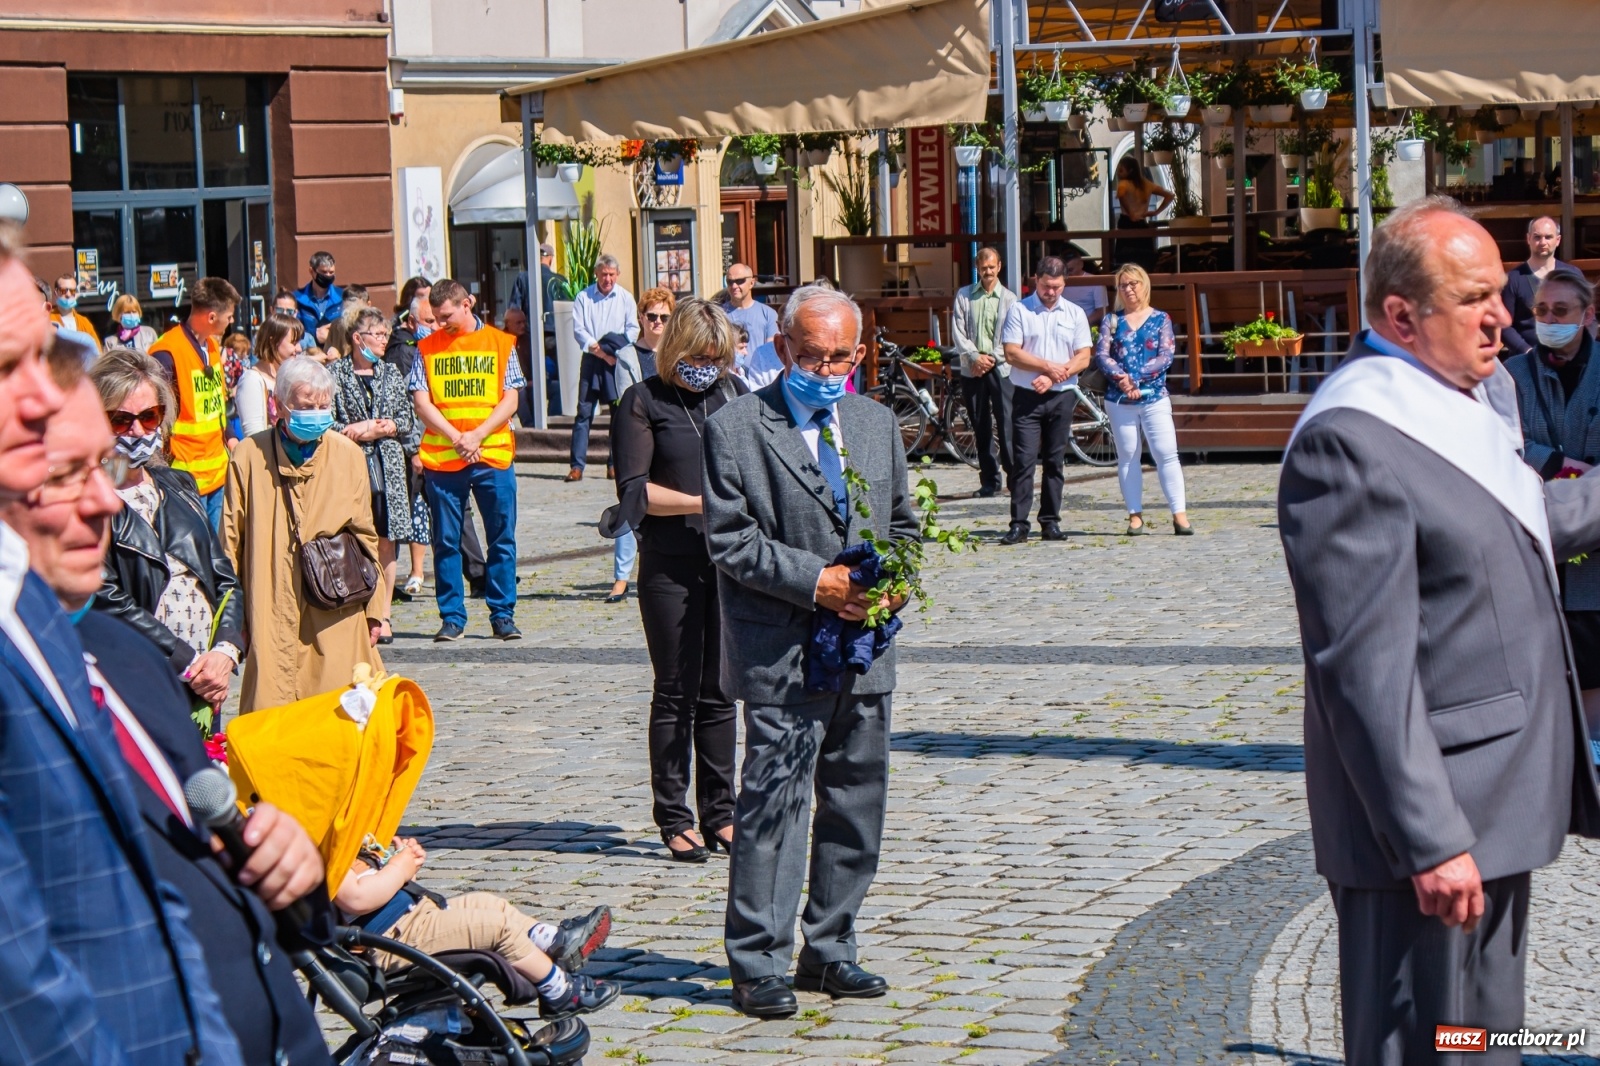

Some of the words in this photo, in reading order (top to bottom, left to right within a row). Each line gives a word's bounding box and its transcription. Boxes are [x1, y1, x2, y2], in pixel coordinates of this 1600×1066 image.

[917, 129, 940, 232] ŻYWIEC
[434, 355, 495, 376] KIEROWANIE
[444, 378, 485, 398] RUCHEM
